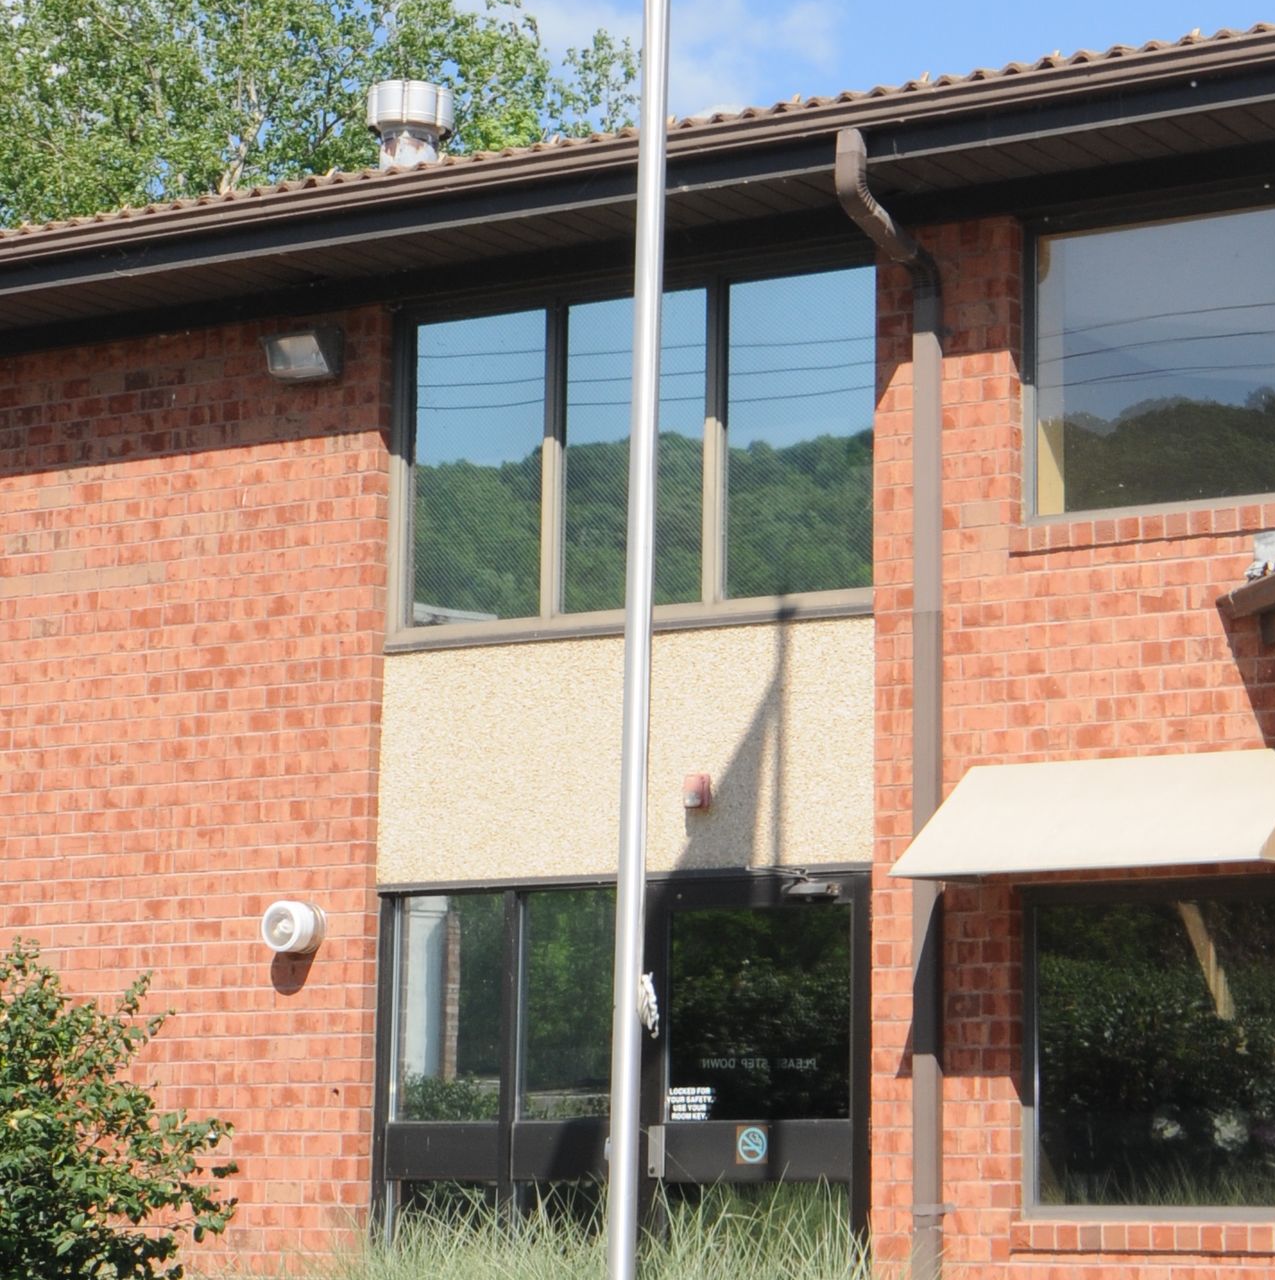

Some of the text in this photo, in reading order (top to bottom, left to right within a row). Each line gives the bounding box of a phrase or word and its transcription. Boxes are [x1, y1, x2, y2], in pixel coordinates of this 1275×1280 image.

[669, 1086, 711, 1095] LOCKED FOR
[666, 1095, 685, 1104] YOUR
[673, 1104, 707, 1112] USE YOUR
[671, 1112, 691, 1120] ROOM
